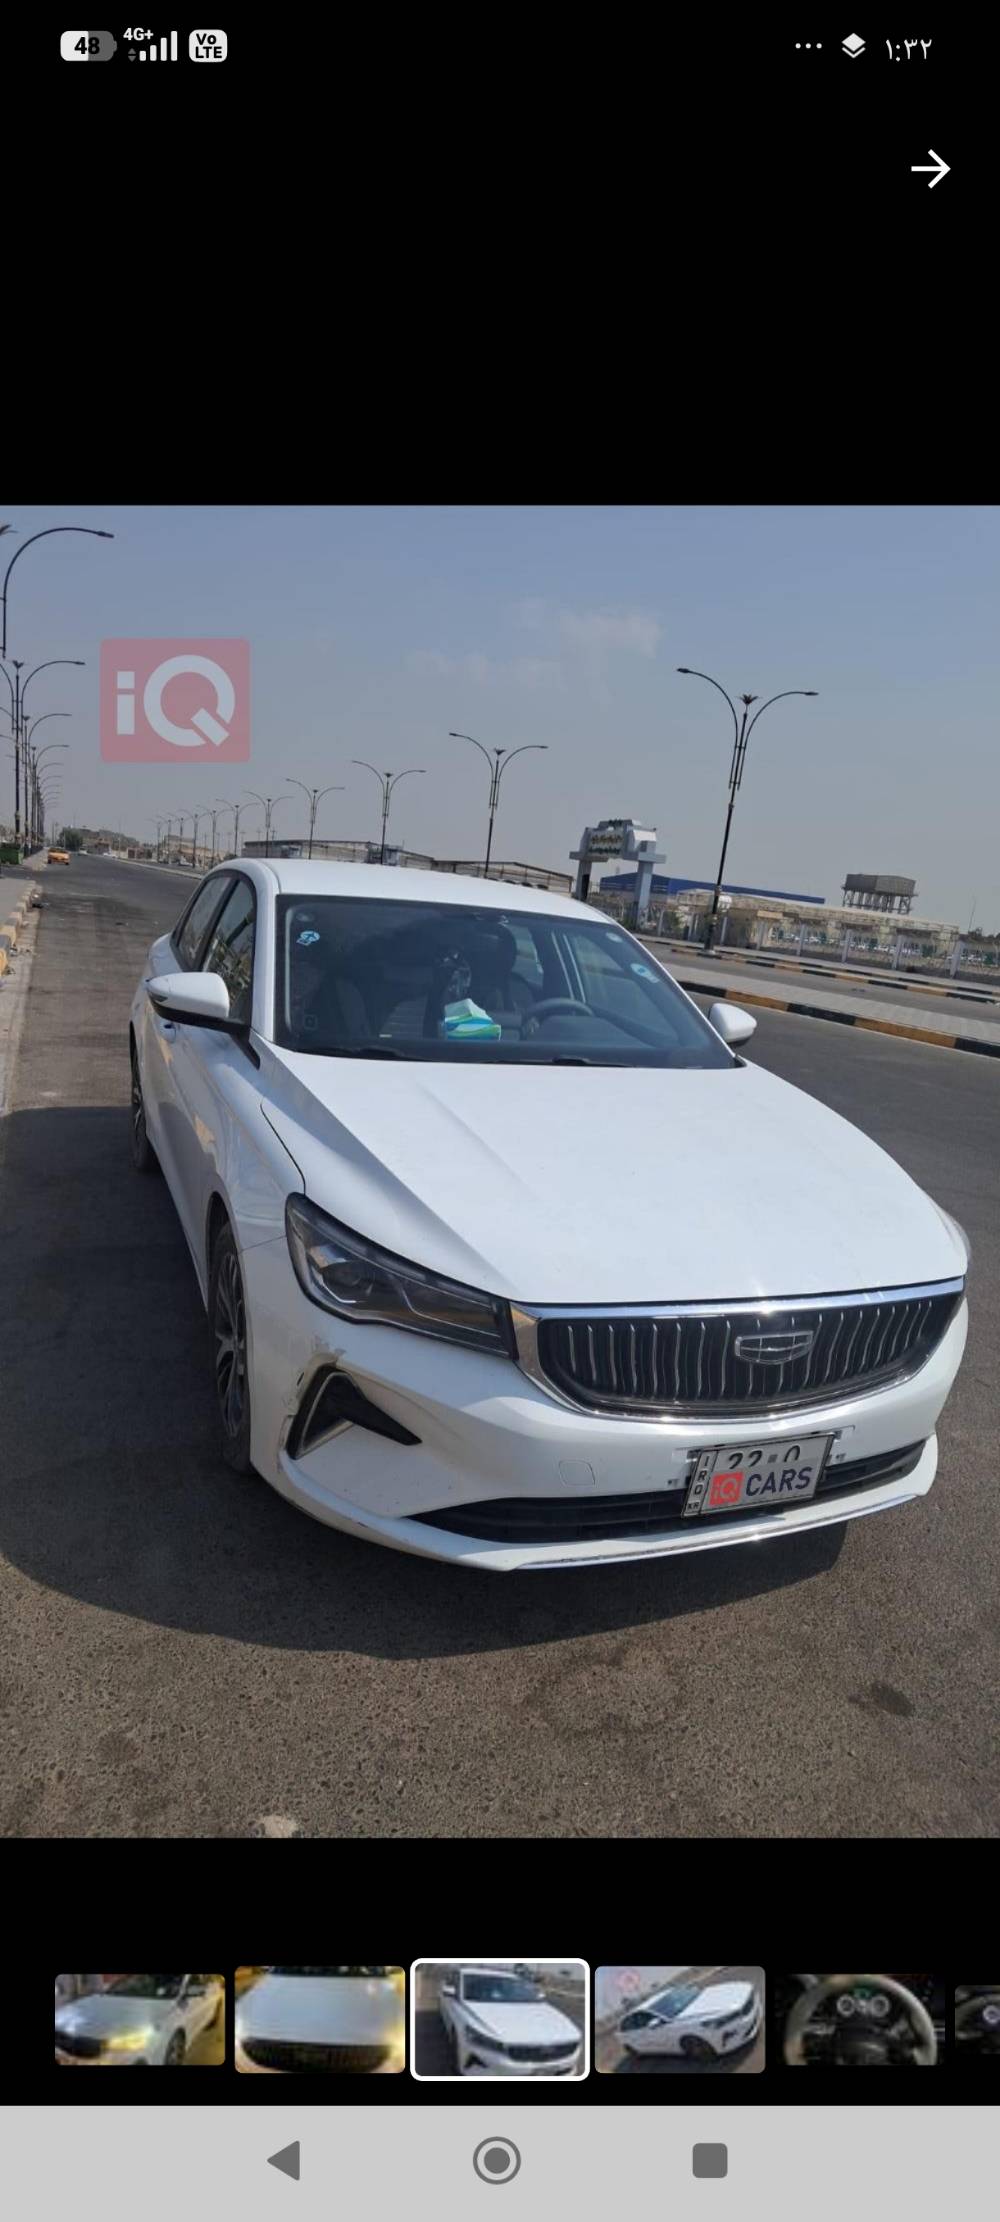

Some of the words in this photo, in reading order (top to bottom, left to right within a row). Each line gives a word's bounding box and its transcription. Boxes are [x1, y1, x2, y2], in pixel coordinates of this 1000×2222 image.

[123, 27, 154, 41] 4G+
[196, 33, 217, 45] Vo
[74, 37, 100, 55] 48
[195, 46, 222, 59] LTE
[886, 39, 932, 62] ١:٣٢
